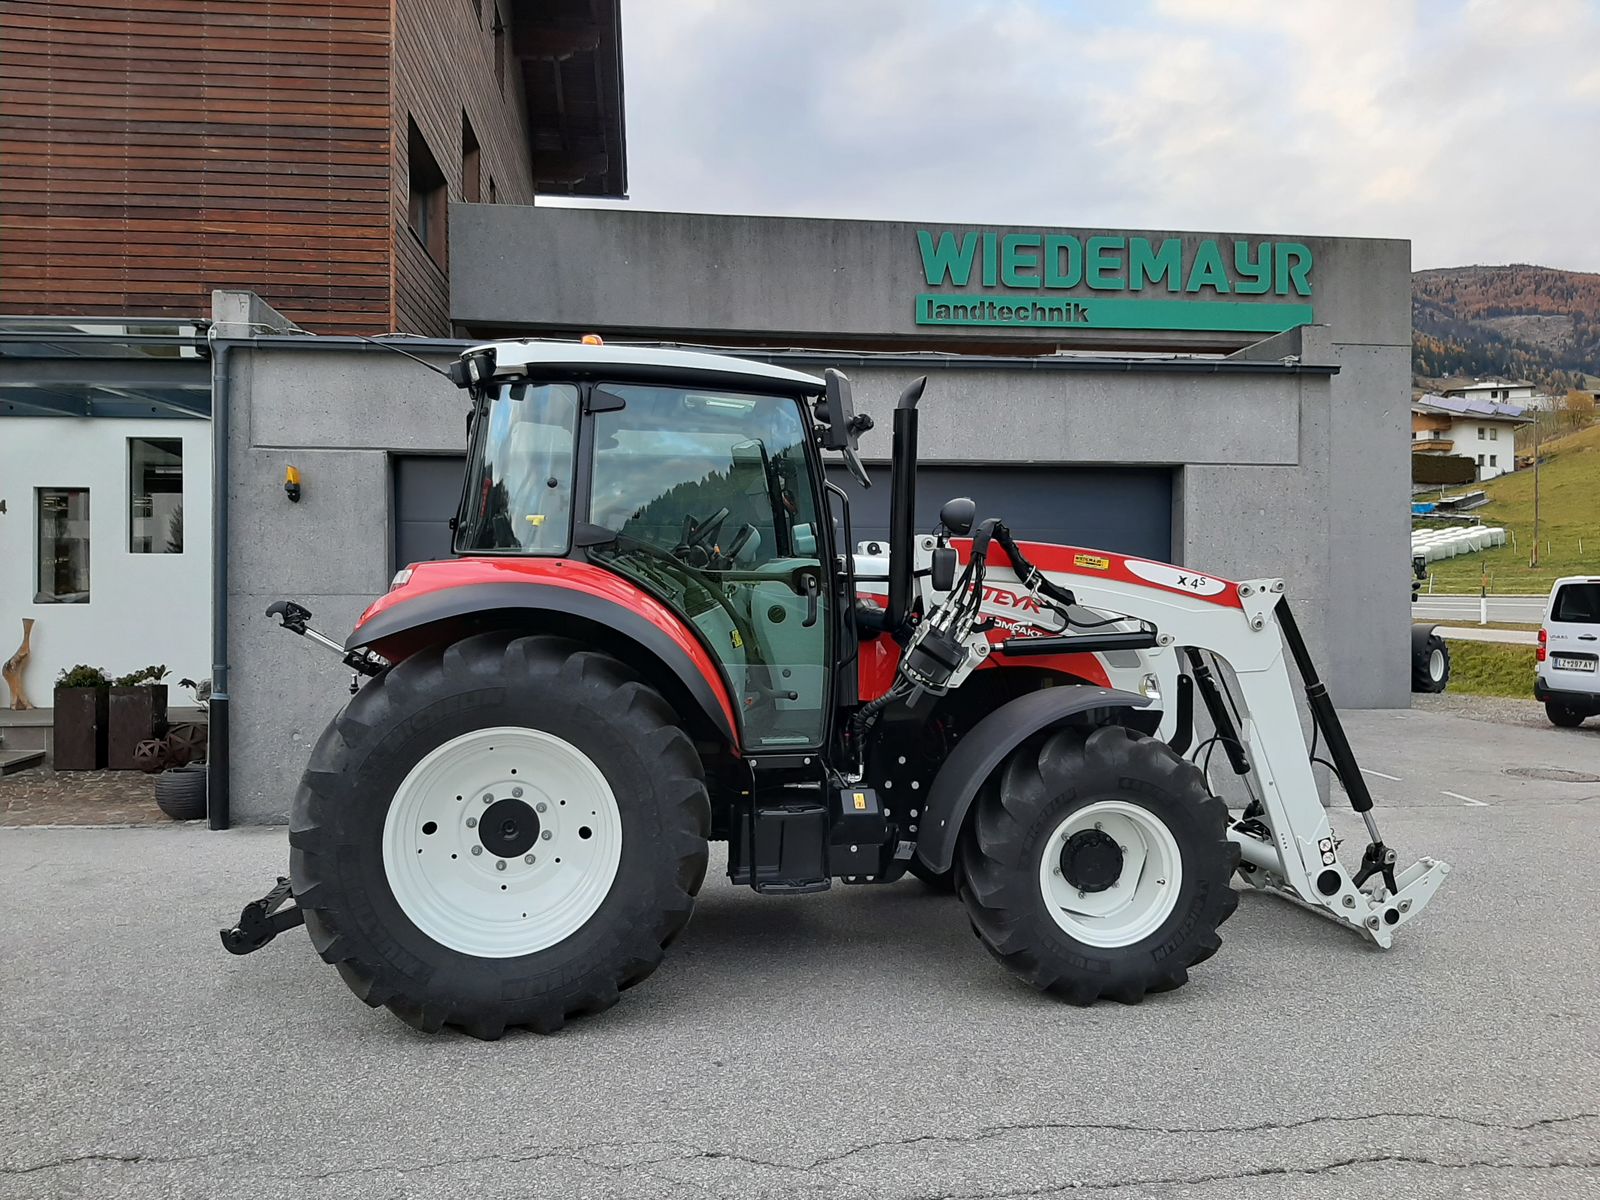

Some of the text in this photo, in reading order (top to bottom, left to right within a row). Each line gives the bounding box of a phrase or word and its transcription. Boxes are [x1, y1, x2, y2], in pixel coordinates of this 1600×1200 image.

[916, 229, 1313, 296] WIEDEMAYR
[926, 299, 1089, 323] landtechnik
[968, 583, 1041, 615] TEYR
